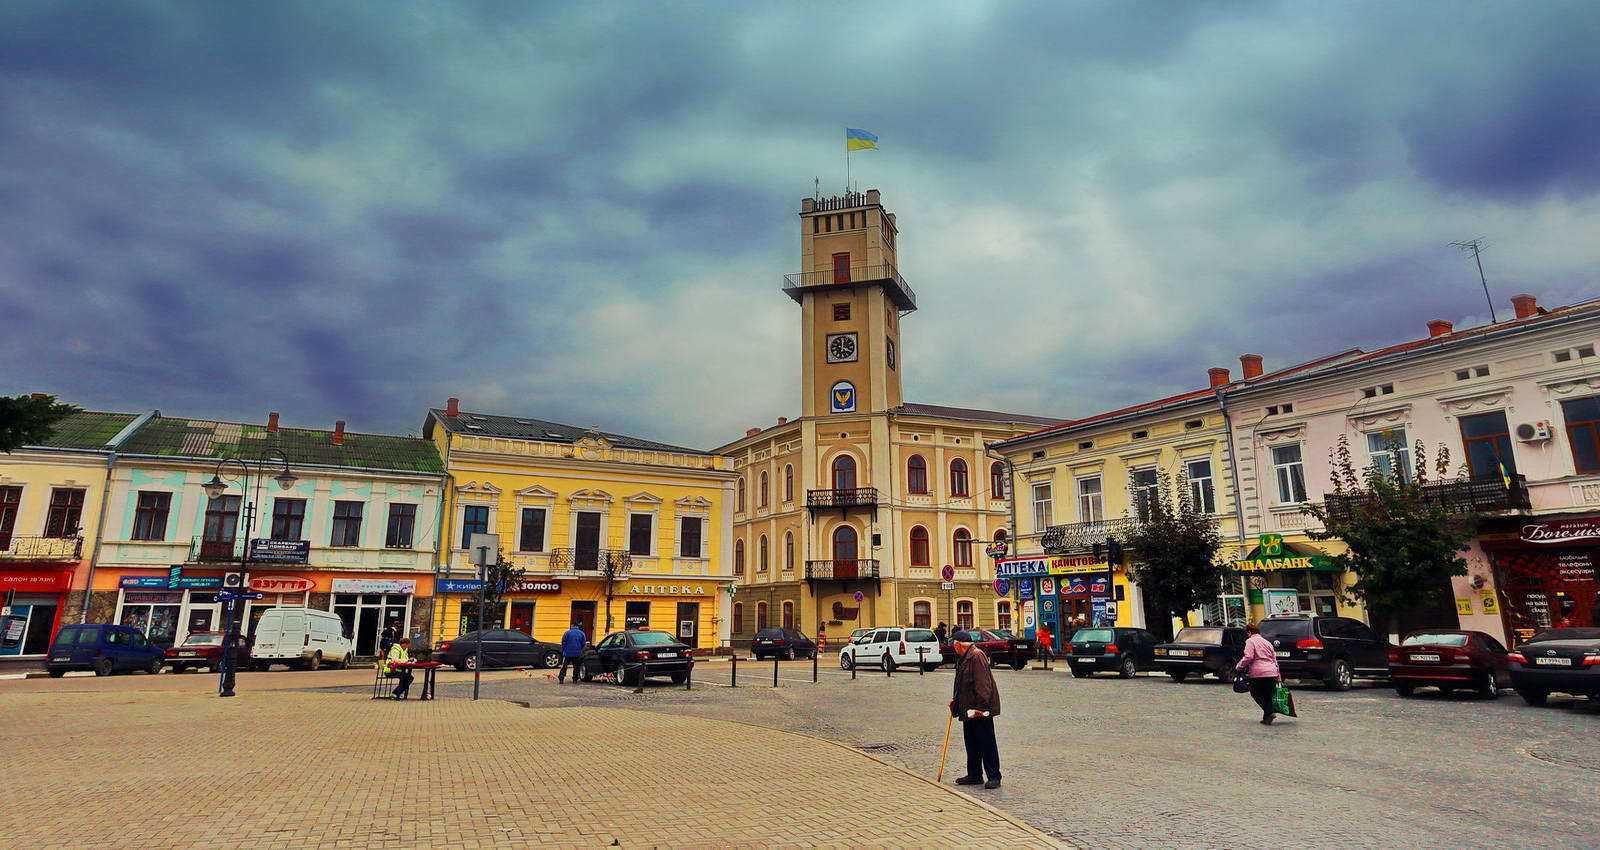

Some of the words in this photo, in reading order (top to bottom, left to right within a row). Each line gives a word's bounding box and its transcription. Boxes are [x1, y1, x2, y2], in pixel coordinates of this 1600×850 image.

[996, 560, 1046, 575] АПТЕКА
[1232, 557, 1314, 572] ОЩАДБАНК
[253, 579, 308, 589] ВЗУТТЯ
[520, 582, 560, 590] ЗОЛОТО
[630, 584, 704, 595] АПТЕКА
